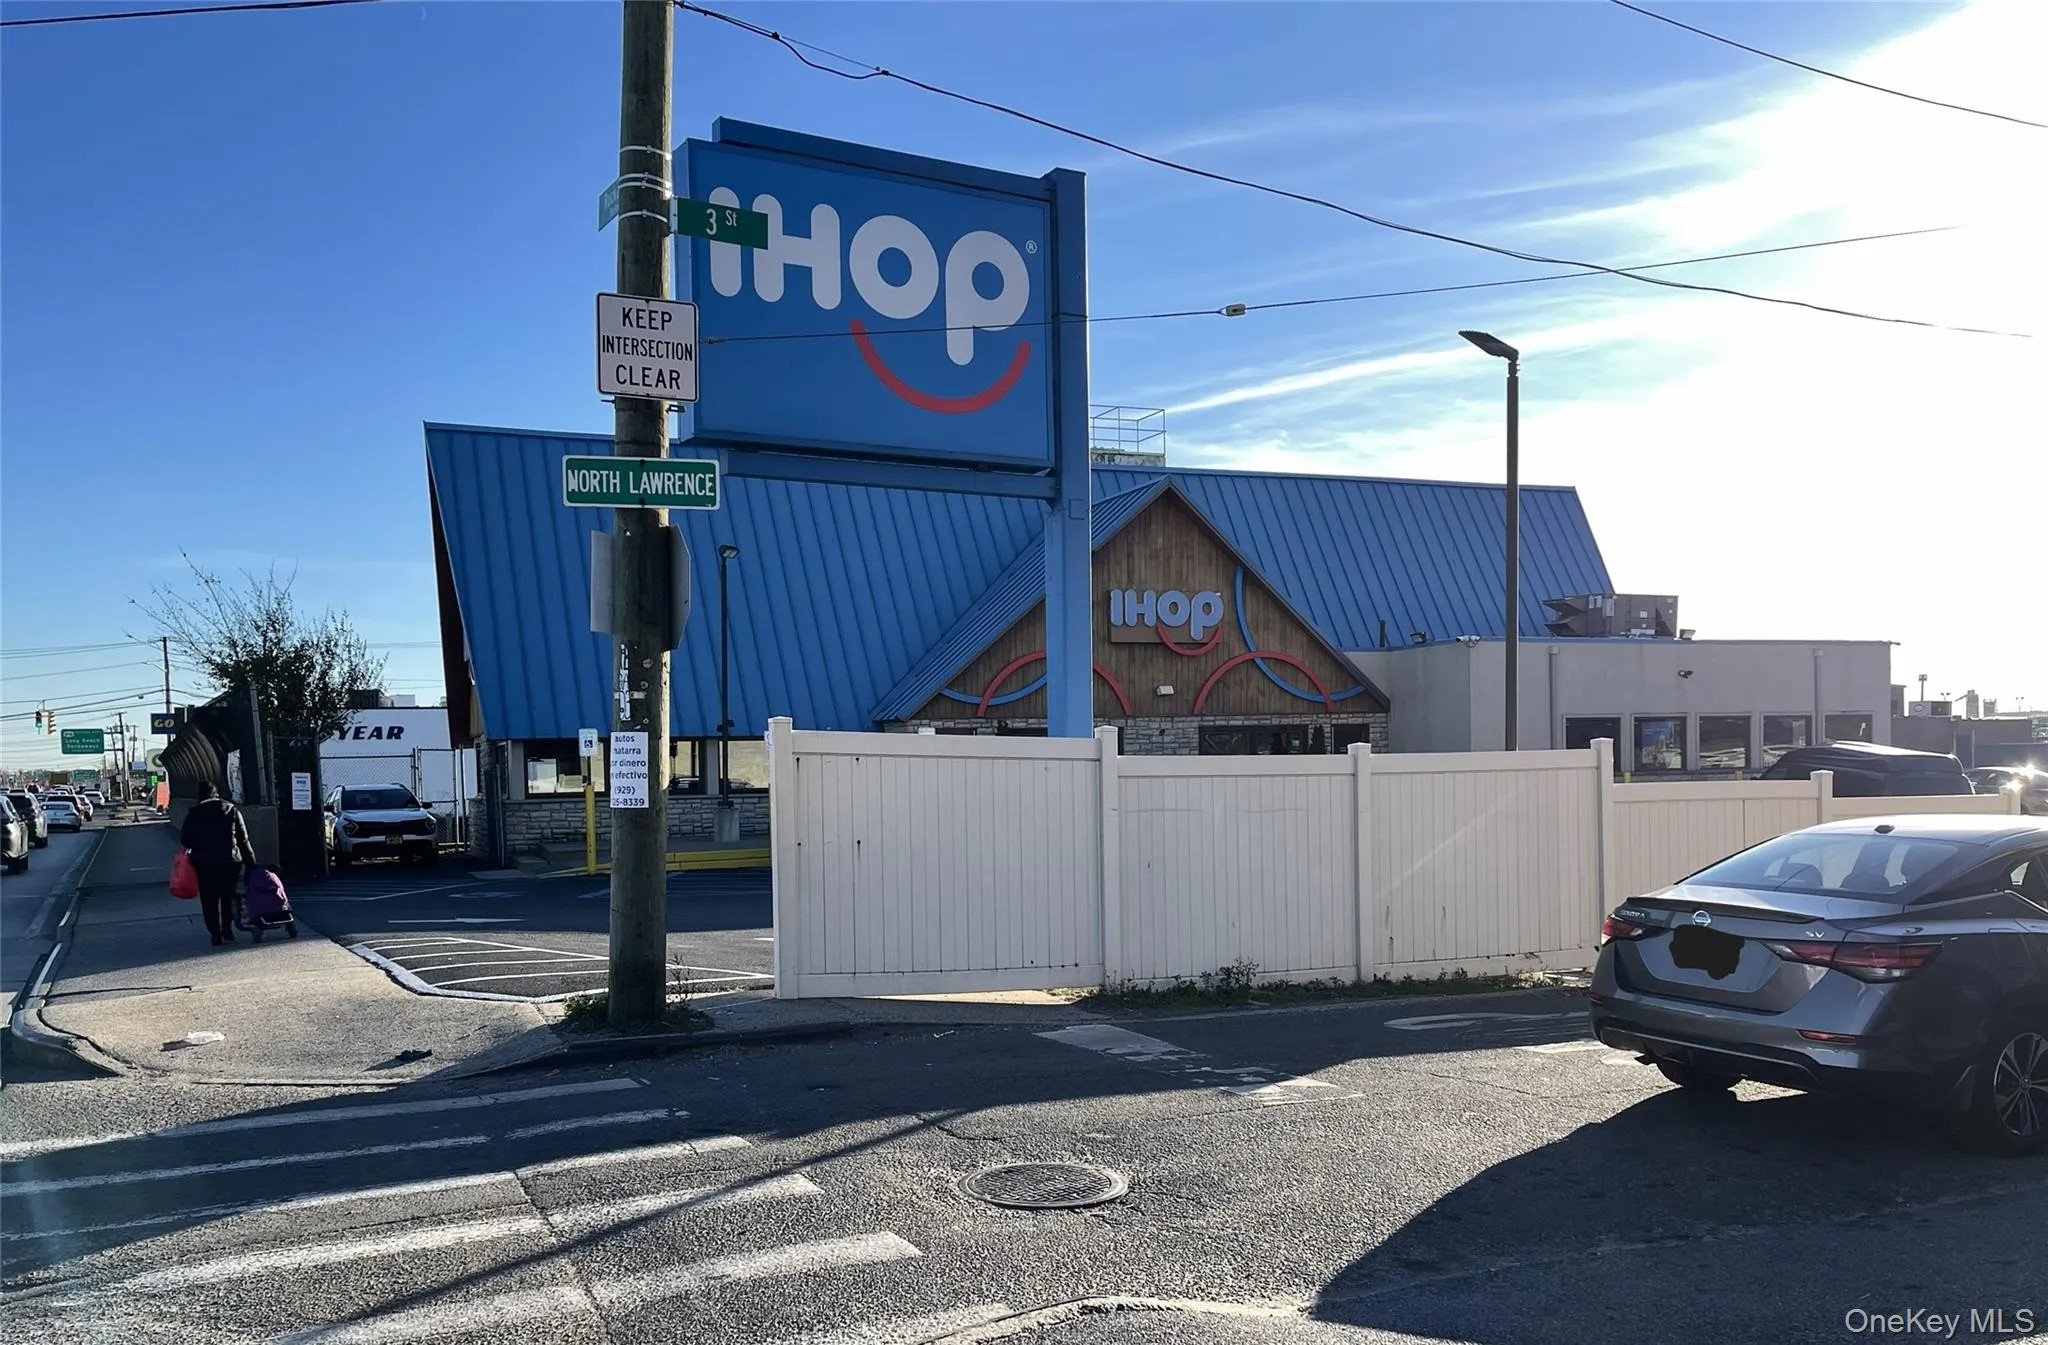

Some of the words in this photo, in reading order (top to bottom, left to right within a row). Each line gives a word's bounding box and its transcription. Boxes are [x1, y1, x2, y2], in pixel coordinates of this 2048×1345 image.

[706, 208, 717, 235] 3
[725, 210, 737, 227] St
[622, 307, 672, 331] KEEP
[602, 335, 693, 362] INTERSECTION
[616, 364, 681, 390] CLEAR
[568, 469, 620, 494] NORTH
[629, 472, 715, 496] LAWRENCE
[615, 735, 635, 743] autos
[615, 770, 647, 779] efectivo
[619, 759, 646, 767] dinero
[1805, 929, 1825, 938] SV
